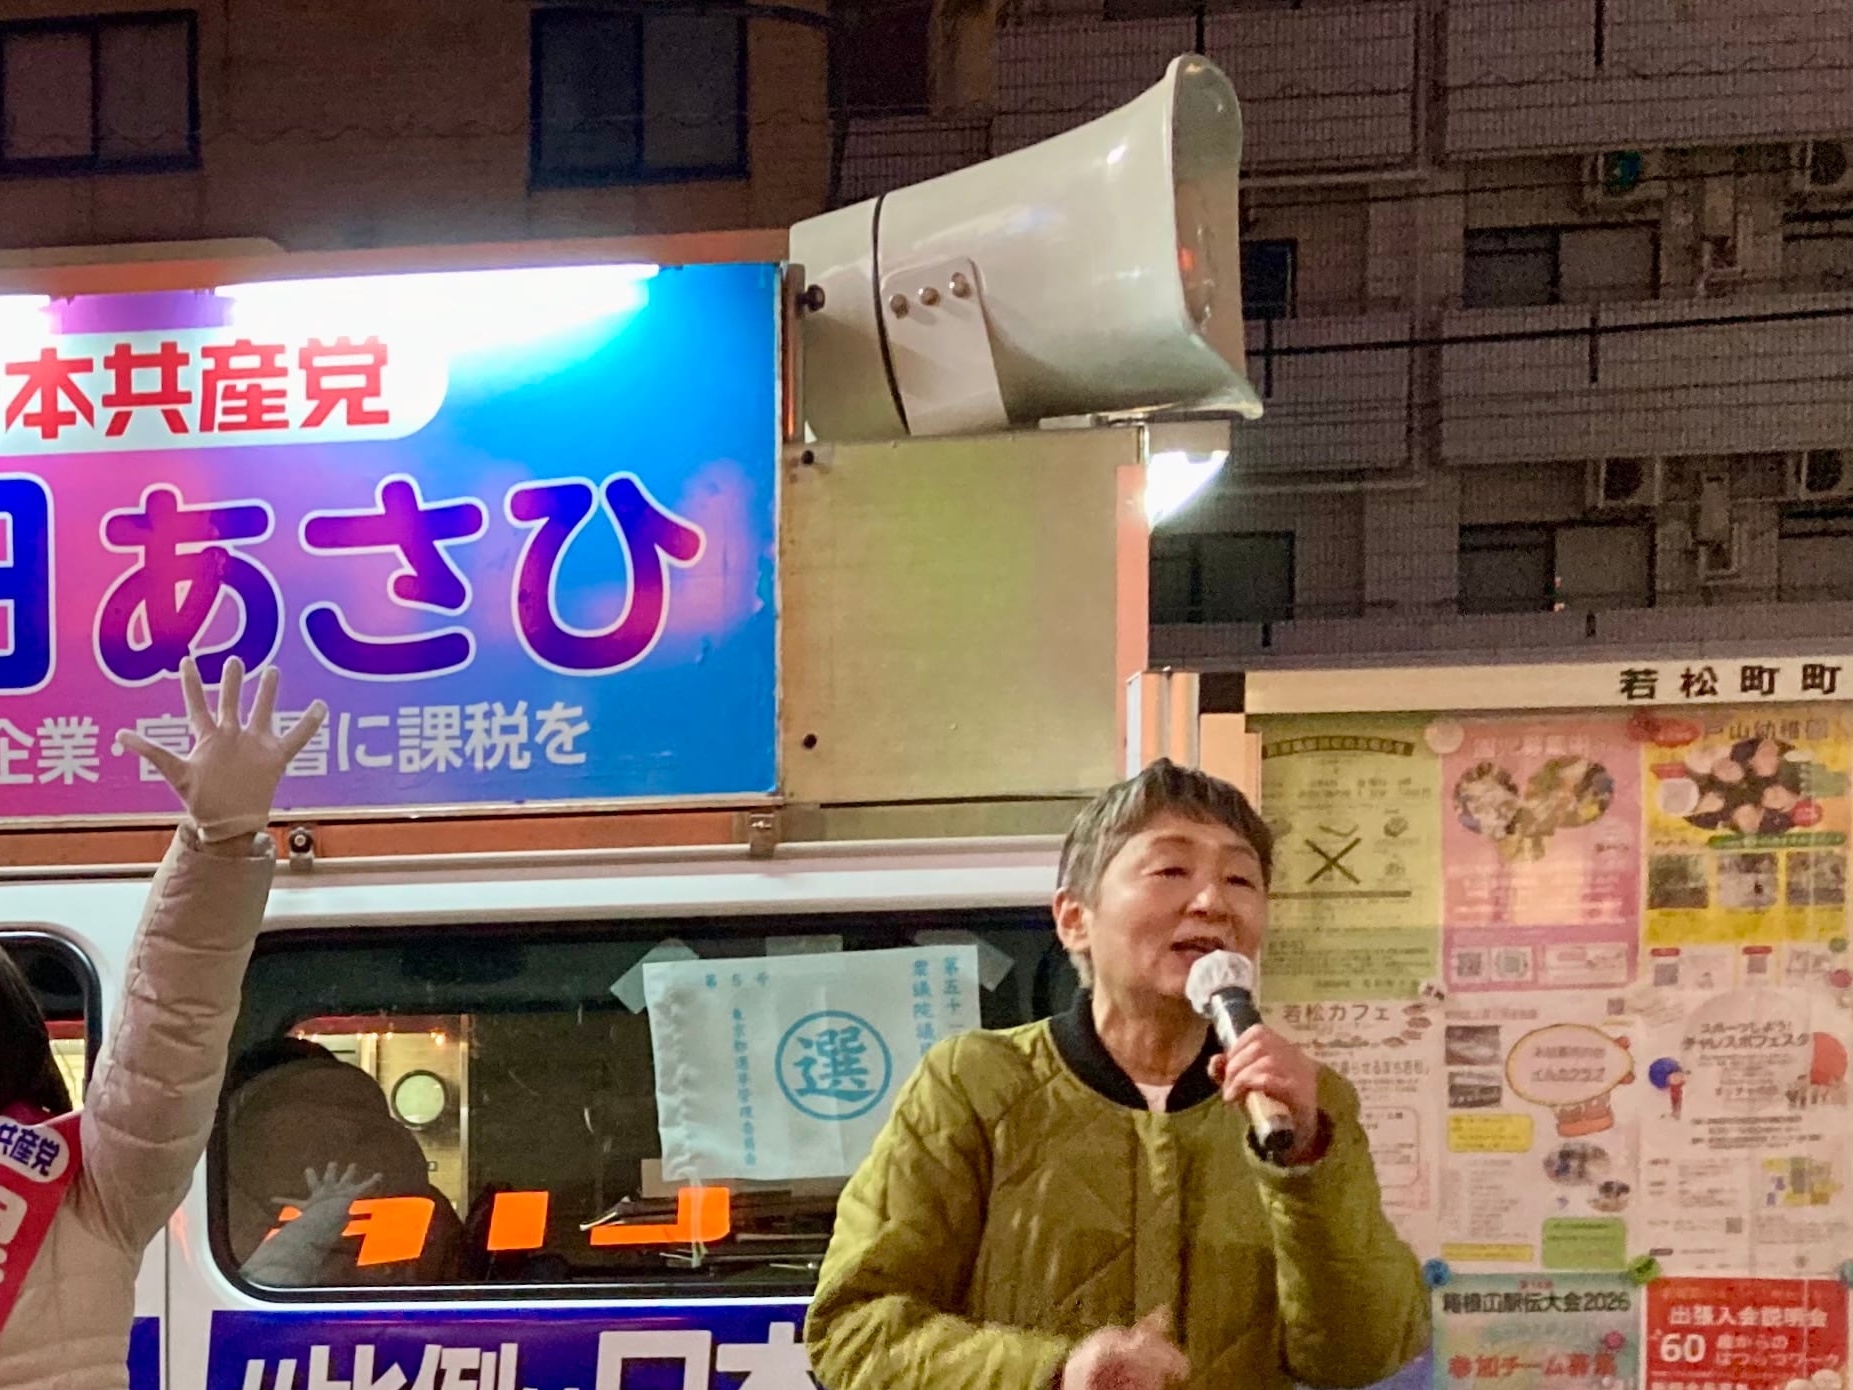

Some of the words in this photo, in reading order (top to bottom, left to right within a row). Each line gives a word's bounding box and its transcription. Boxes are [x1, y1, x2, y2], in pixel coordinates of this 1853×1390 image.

[1282, 1003, 1391, 1024] 若松カフェ
[792, 1025, 877, 1102] 選
[1660, 1332, 1707, 1364] 60
